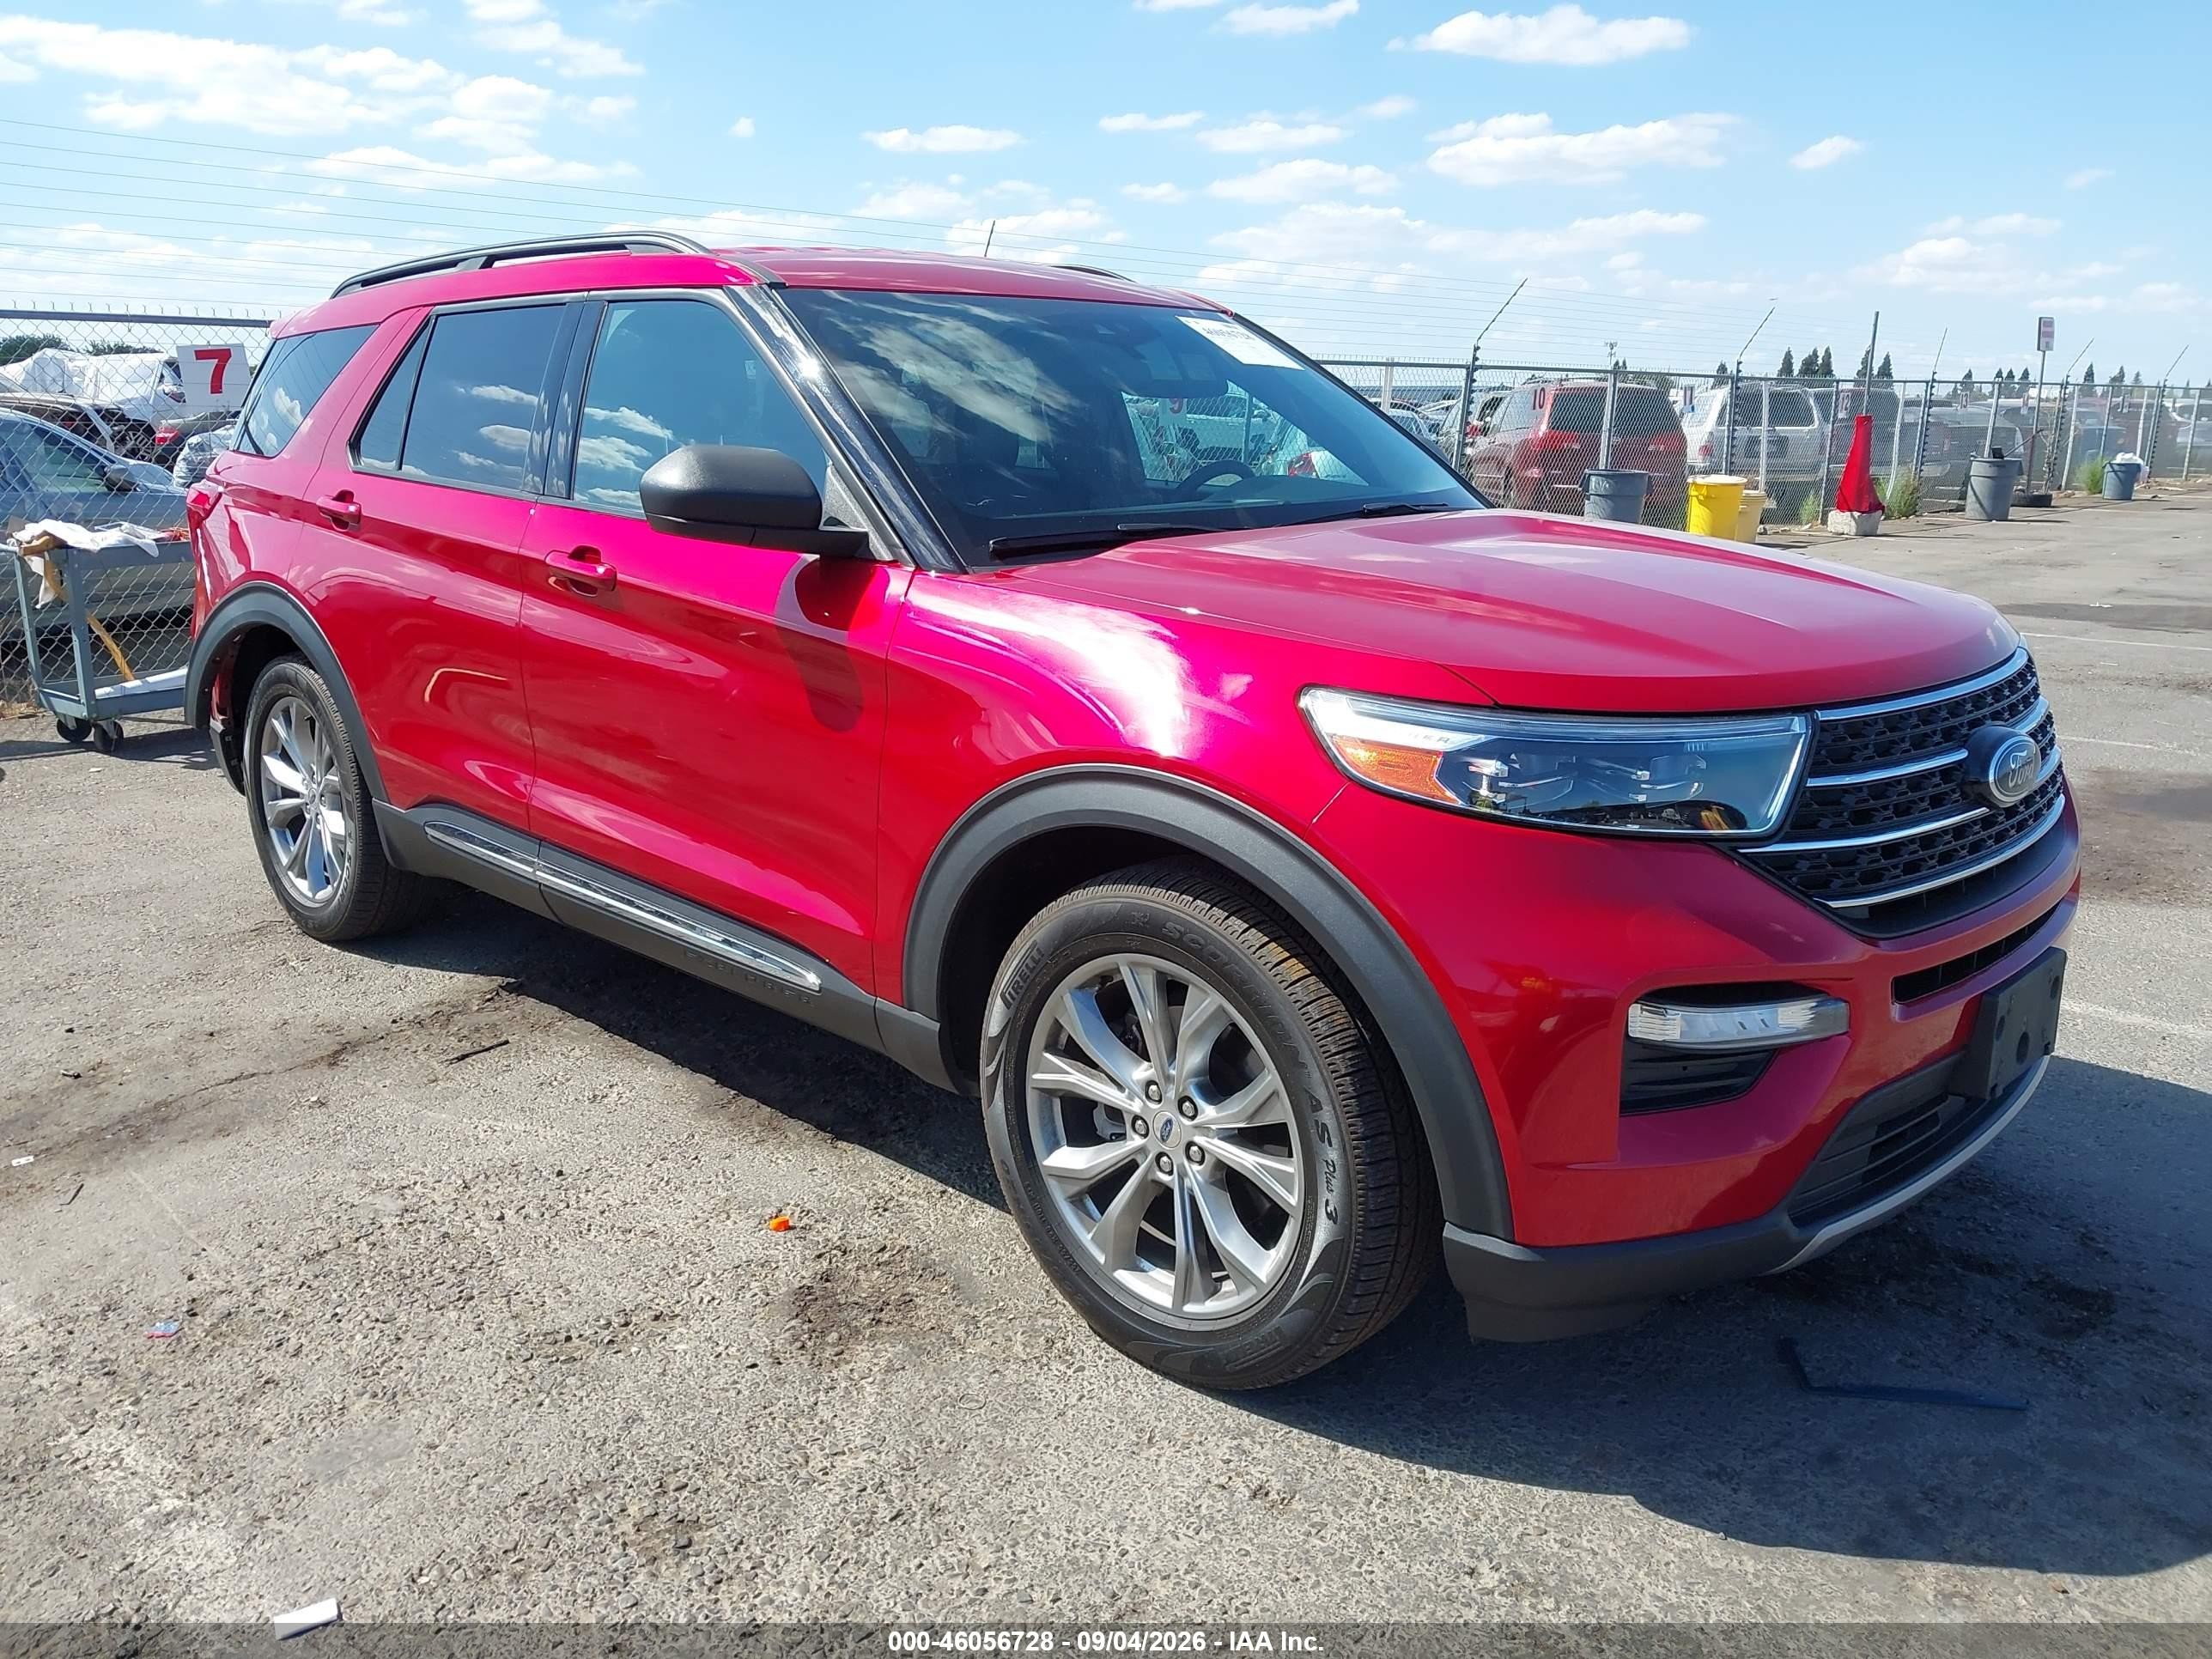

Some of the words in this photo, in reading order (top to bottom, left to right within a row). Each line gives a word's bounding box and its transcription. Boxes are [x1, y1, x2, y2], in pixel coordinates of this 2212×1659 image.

[194, 349, 232, 394] 7
[1533, 387, 1546, 410] 10
[2009, 750, 2034, 788] Ford
[1000, 939, 1045, 1010] PIRELLI
[1322, 1158, 1337, 1194] Plus
[1325, 1199, 1339, 1225] 3
